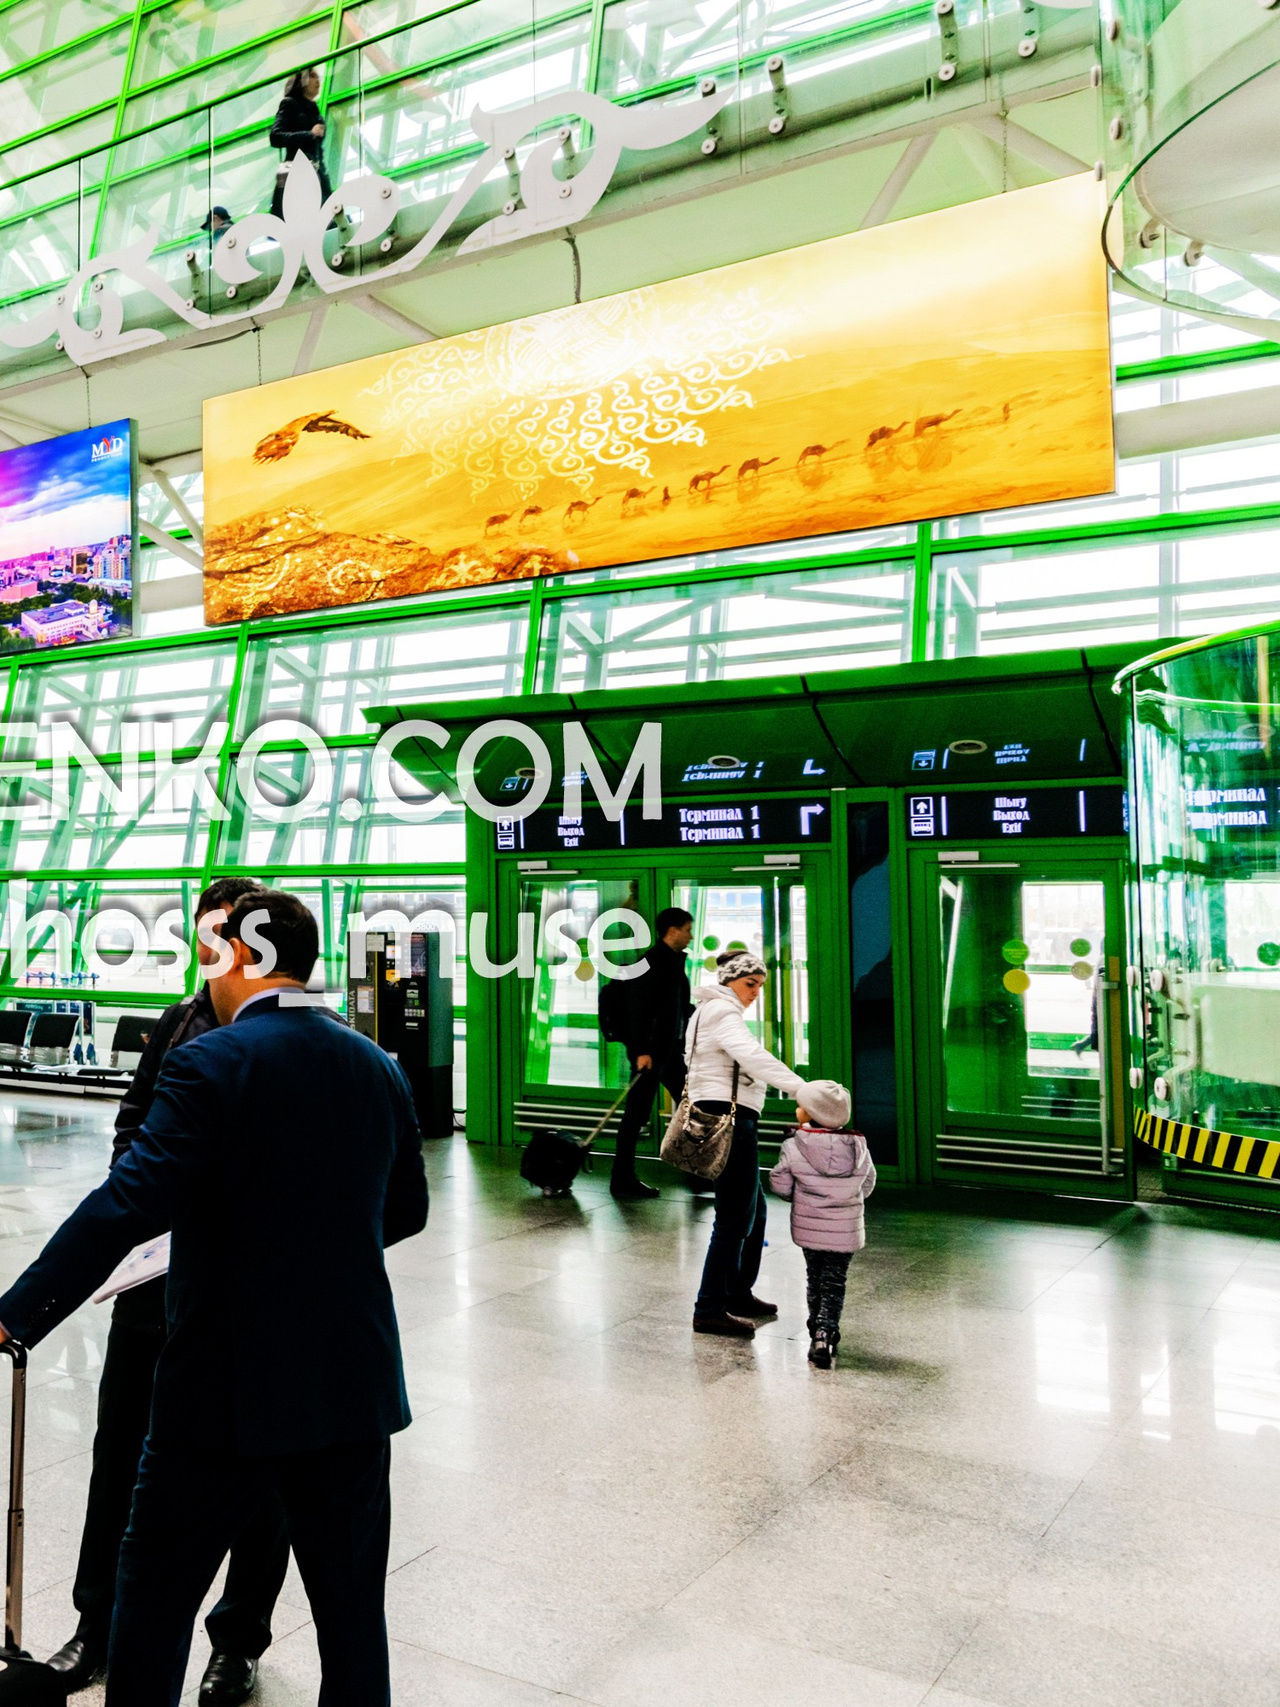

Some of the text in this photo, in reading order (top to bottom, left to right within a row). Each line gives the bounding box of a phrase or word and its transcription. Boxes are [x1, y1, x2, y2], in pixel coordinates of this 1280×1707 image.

[679, 805, 760, 824] Терминал 1
[992, 810, 1030, 822] Выход
[680, 824, 760, 843] Терминал 1
